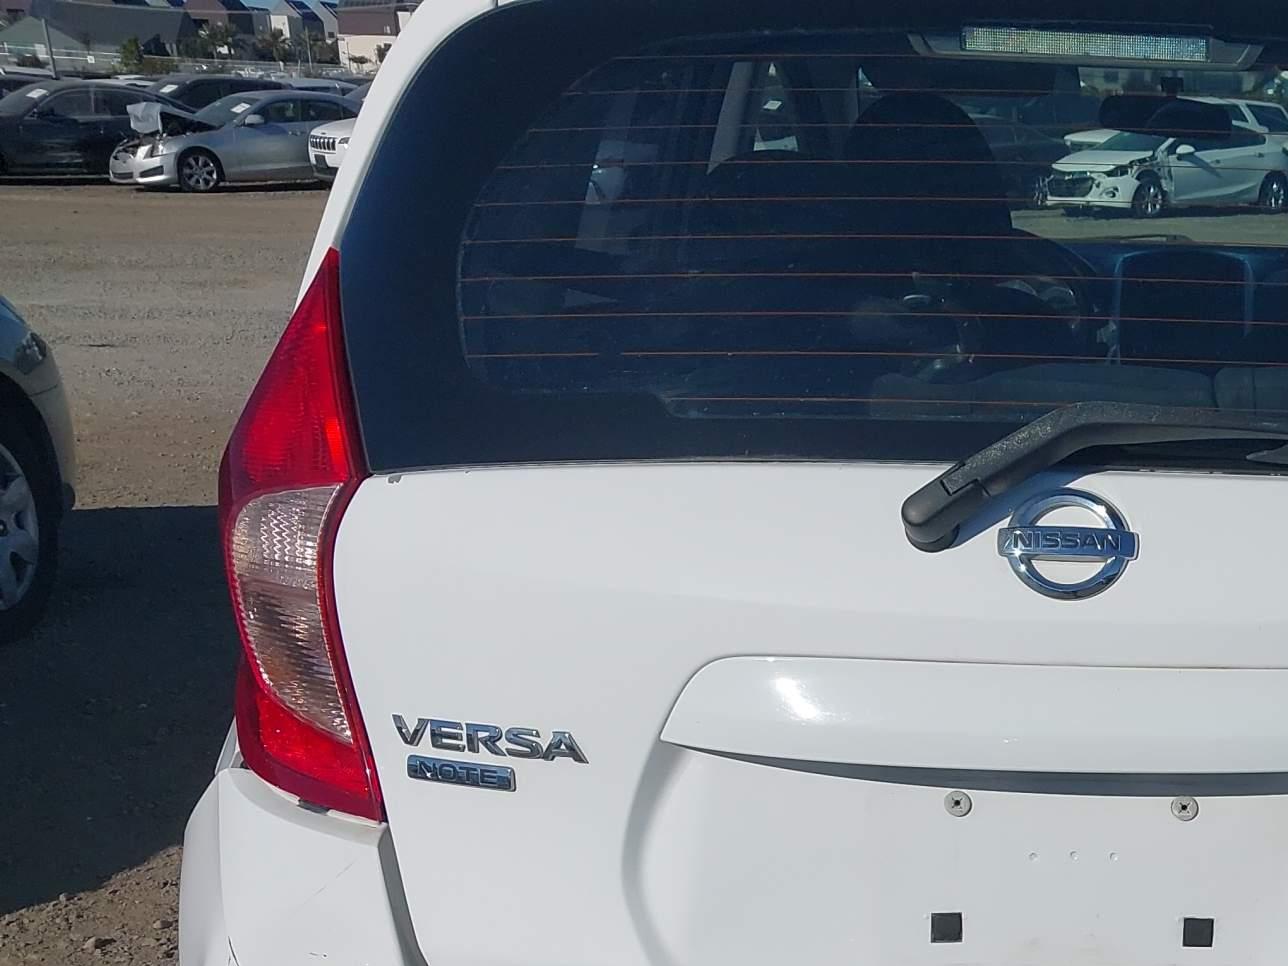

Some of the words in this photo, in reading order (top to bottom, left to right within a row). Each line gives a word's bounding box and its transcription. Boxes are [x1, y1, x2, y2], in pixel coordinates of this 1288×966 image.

[1012, 530, 1121, 552] NISSAN
[391, 713, 590, 765] VERSA
[416, 759, 499, 786] NOTE
